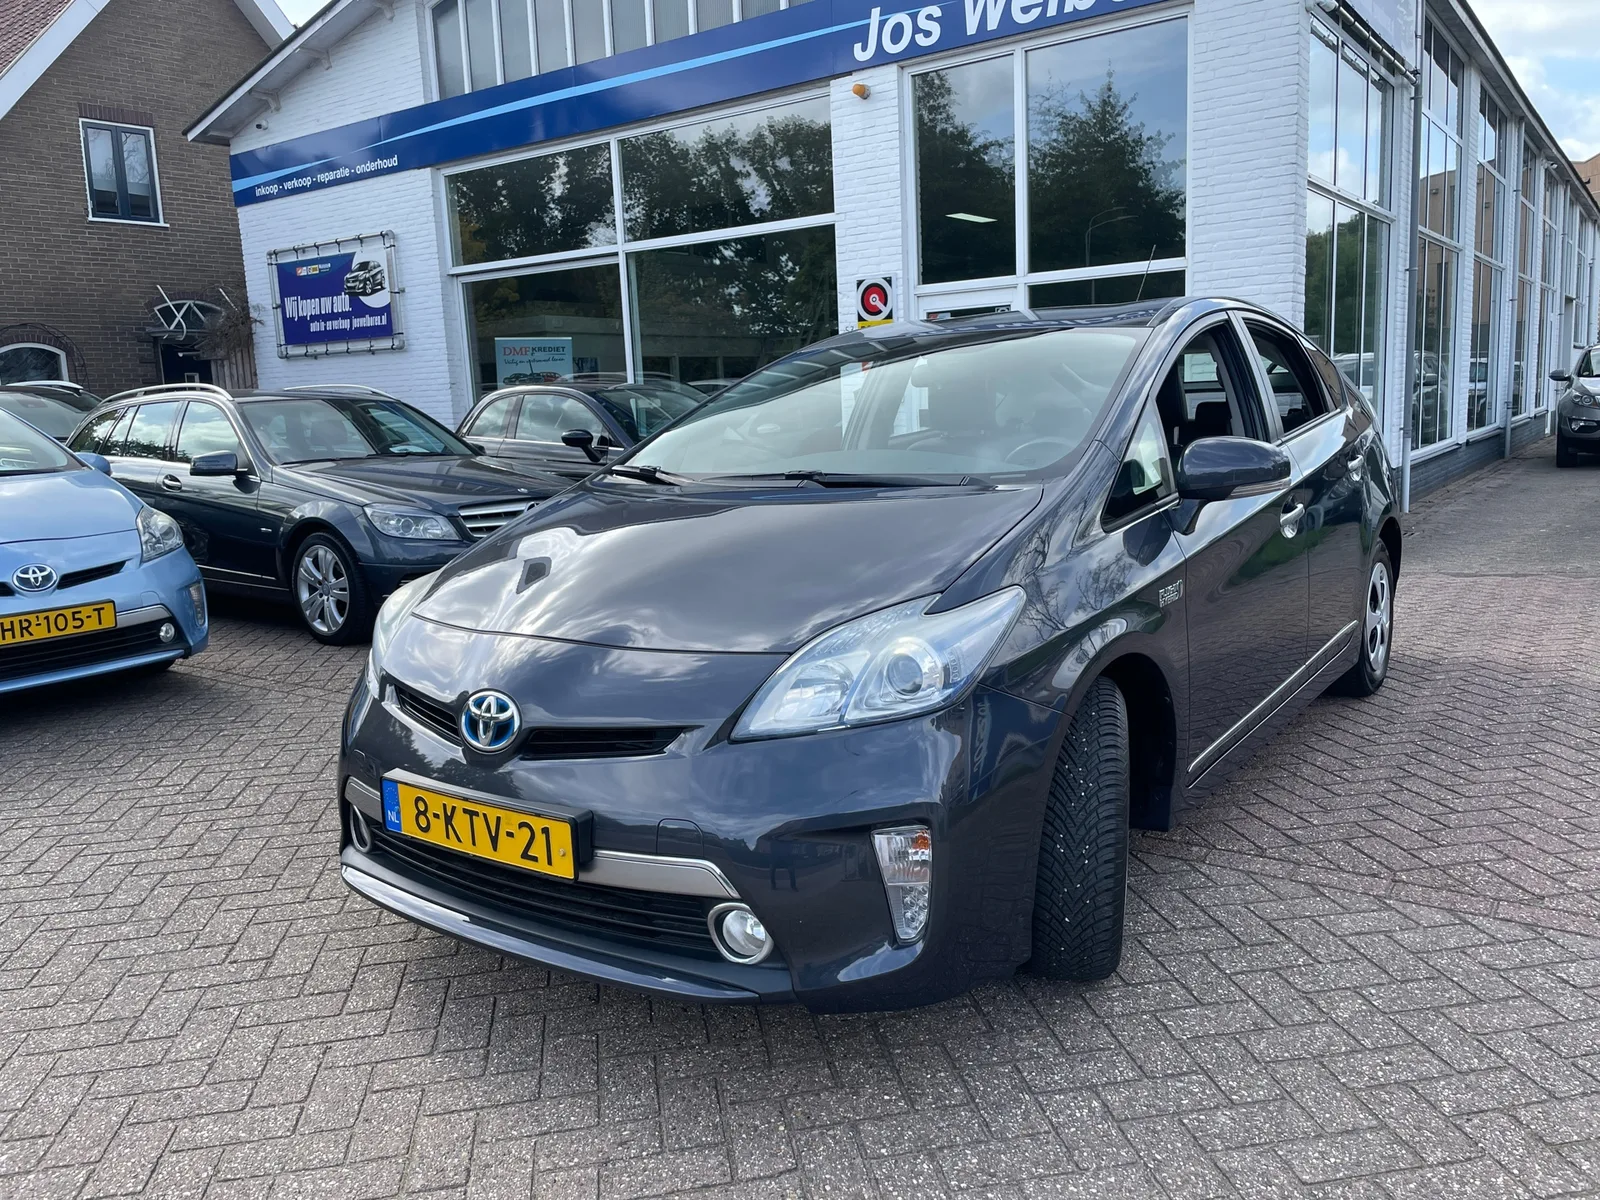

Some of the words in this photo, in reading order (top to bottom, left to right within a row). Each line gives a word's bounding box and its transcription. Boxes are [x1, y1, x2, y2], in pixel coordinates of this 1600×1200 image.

[853, 5, 943, 62] Jos
[255, 184, 279, 197] inkoop
[283, 176, 312, 190] verkoop
[317, 166, 350, 183] reparatie
[356, 155, 398, 174] onderhoud
[284, 296, 298, 322] Wij
[298, 295, 320, 320] kopen
[320, 296, 332, 314] uw
[333, 291, 352, 313] auto.
[503, 346, 530, 357] DMF
[531, 346, 566, 354] KREDIET
[0, 607, 105, 641] HR-105-T
[388, 810, 400, 824] NL
[414, 795, 553, 867] 8-KTV-21
